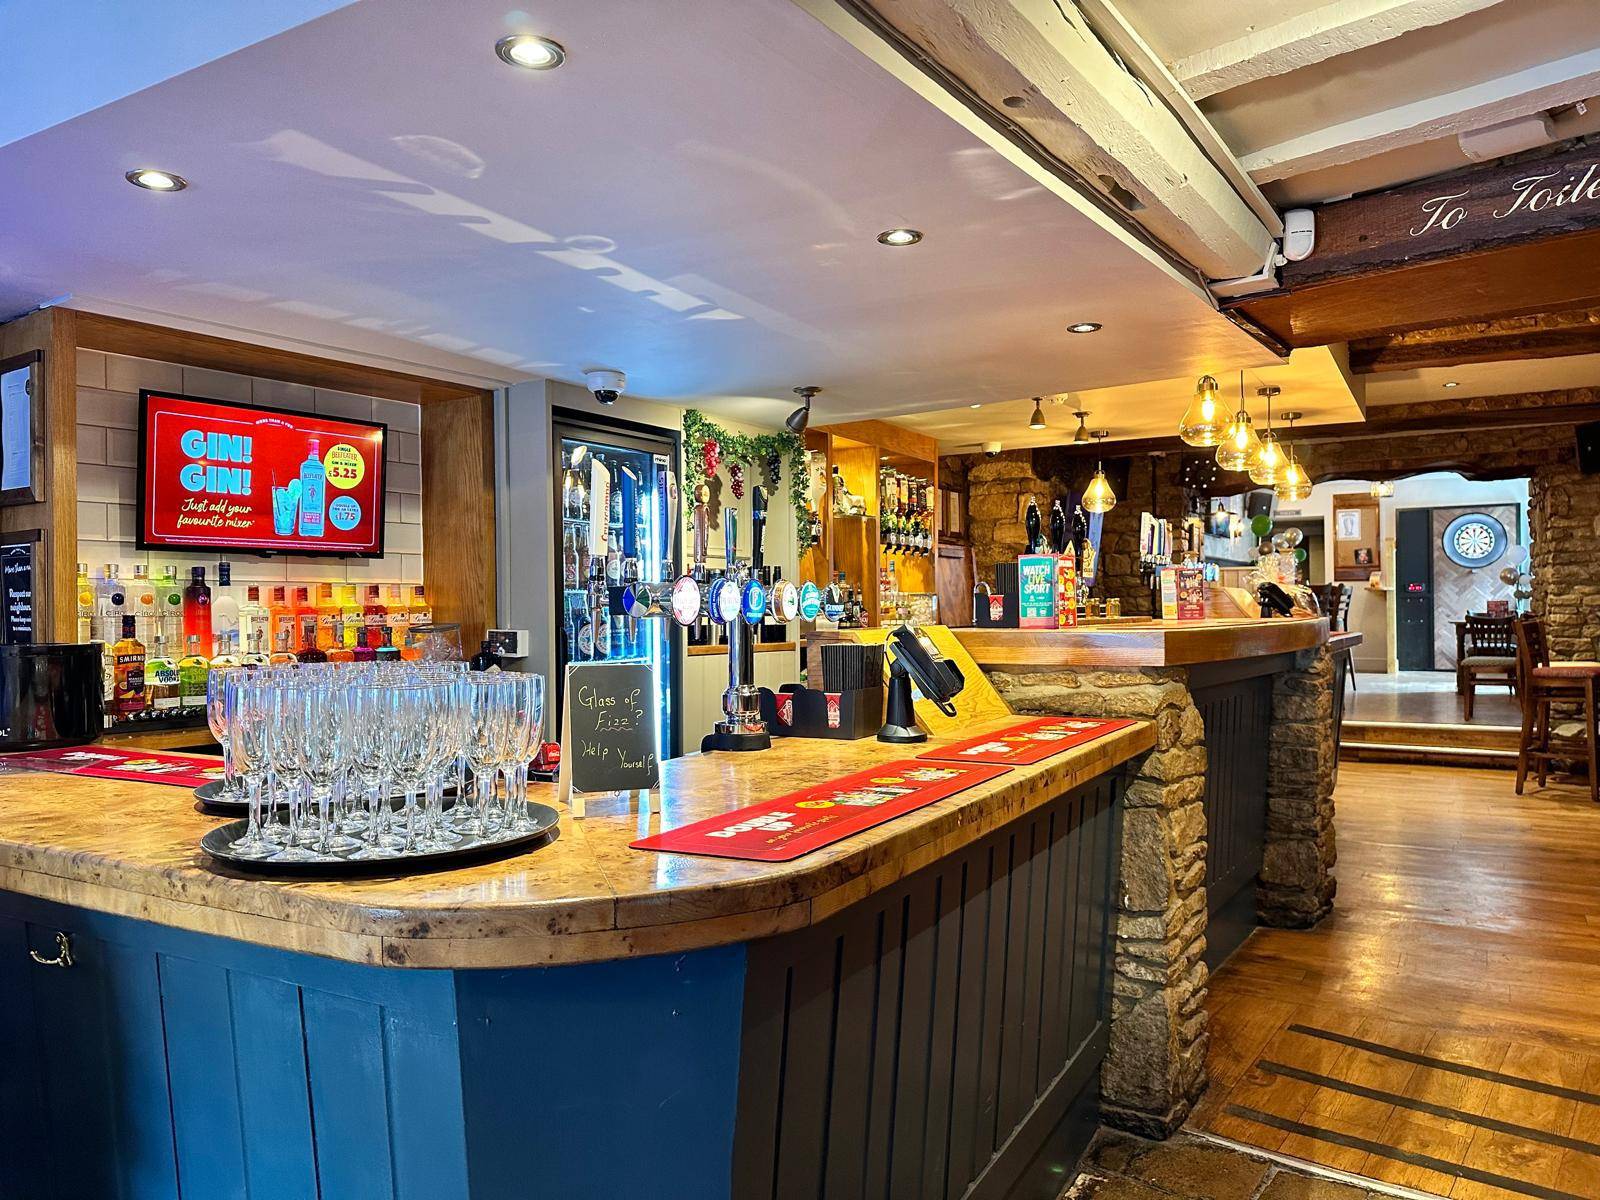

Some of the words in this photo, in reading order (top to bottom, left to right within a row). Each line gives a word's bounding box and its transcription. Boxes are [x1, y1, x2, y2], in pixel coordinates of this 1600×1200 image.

[1410, 190, 1469, 236] To
[181, 429, 253, 464] GIN!
[331, 451, 357, 461] BEEFEATER
[180, 463, 252, 496] GIN!
[328, 467, 358, 479] £5.25
[181, 497, 208, 512] Just
[209, 499, 228, 513] add
[226, 504, 253, 517] your
[177, 514, 223, 529] favourite
[1023, 565, 1050, 576] WATCH
[1027, 574, 1045, 585] LIVE
[1024, 584, 1050, 594] SPORT
[578, 685, 616, 710] Glass
[624, 688, 641, 712] of
[581, 740, 609, 761] Help
[617, 748, 654, 776] Yourself
[704, 811, 797, 838] DOUBLE
[756, 820, 796, 832] UP
